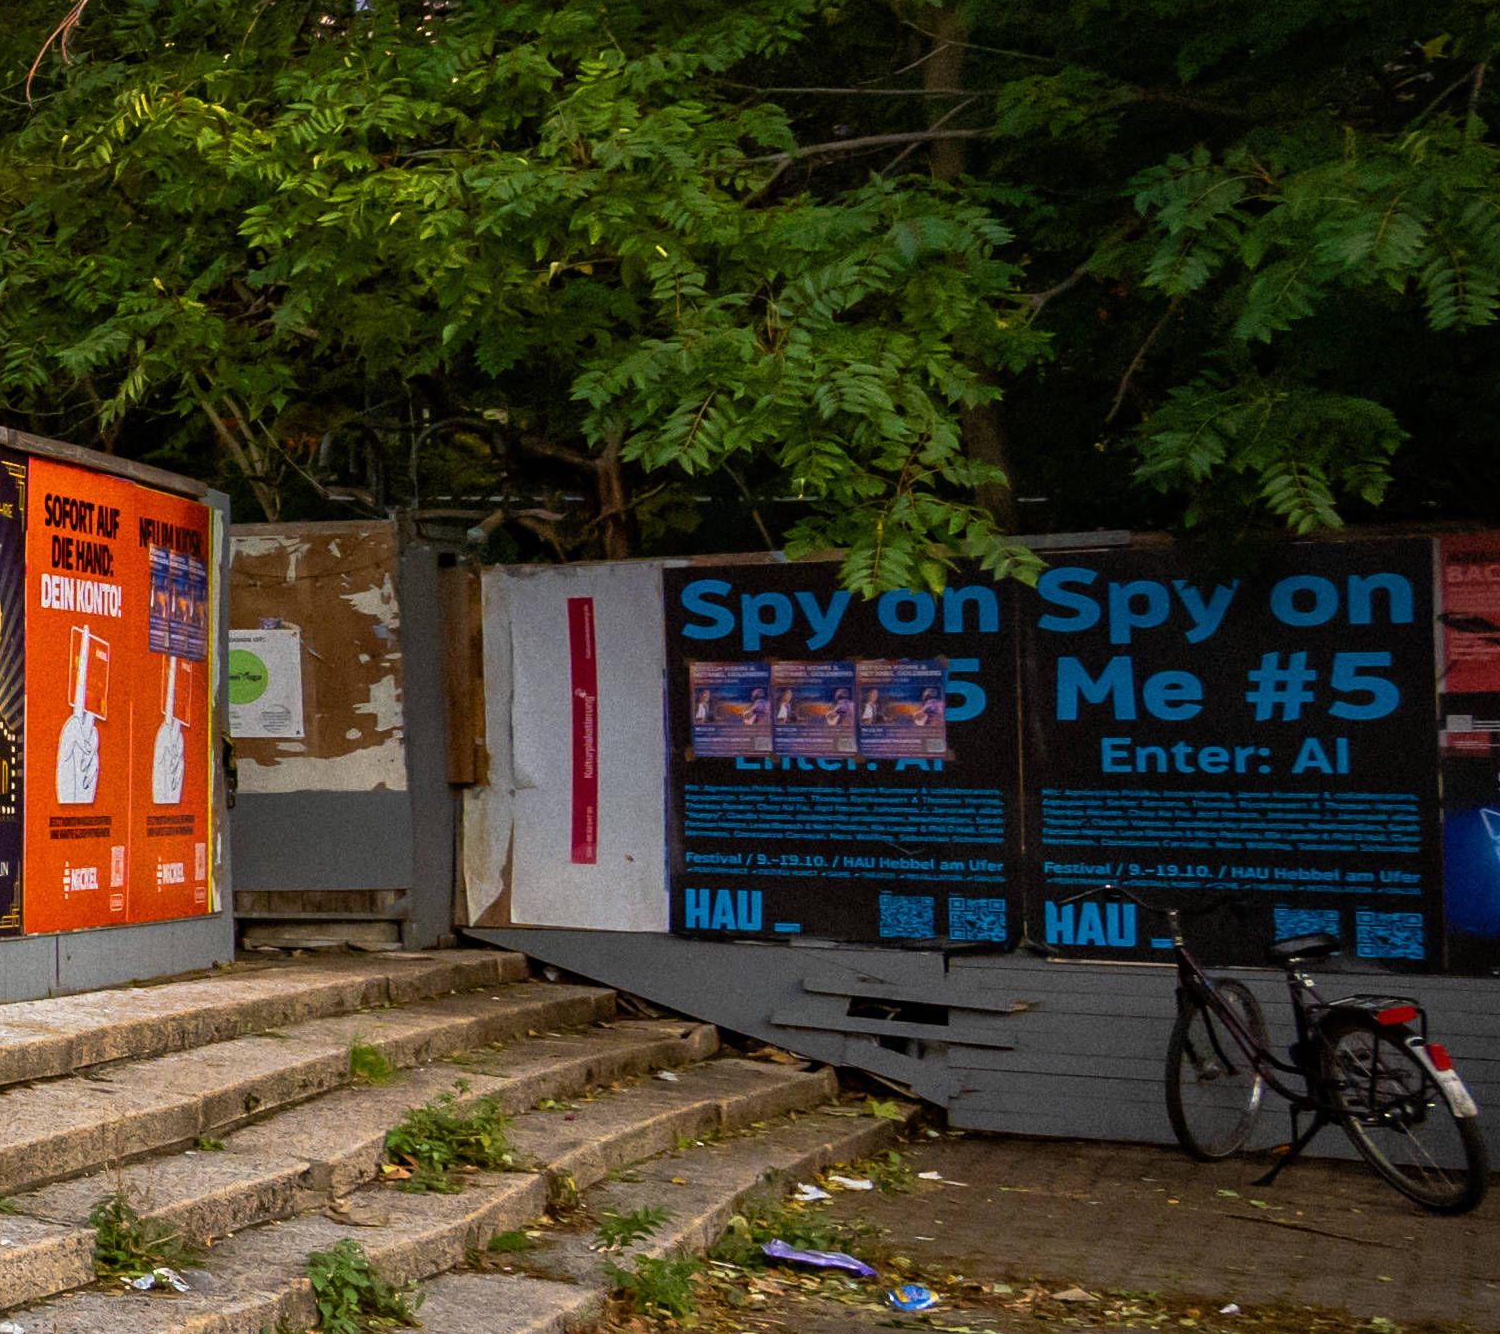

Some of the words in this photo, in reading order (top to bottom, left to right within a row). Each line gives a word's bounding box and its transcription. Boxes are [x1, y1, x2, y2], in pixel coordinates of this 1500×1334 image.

[45, 493, 94, 534] SOFORT
[97, 505, 120, 539] AUF
[52, 535, 73, 570] DIE
[76, 540, 114, 576] HAND:
[41, 573, 74, 611] DEIN
[77, 579, 121, 618] KONTO!
[680, 579, 852, 651] Spy
[877, 587, 1000, 634] on
[1036, 567, 1240, 644] Spy
[1270, 573, 1415, 626] on
[1056, 655, 1204, 721] Me
[1245, 651, 1400, 721] #5
[1101, 737, 1270, 775] Enter:
[685, 852, 742, 864] Festival
[843, 857, 875, 868] HAU
[879, 858, 934, 870] Hebbel
[940, 862, 965, 870] am
[969, 860, 1004, 871] Ufer
[685, 888, 763, 931] HAU
[1044, 901, 1138, 947] HAU
